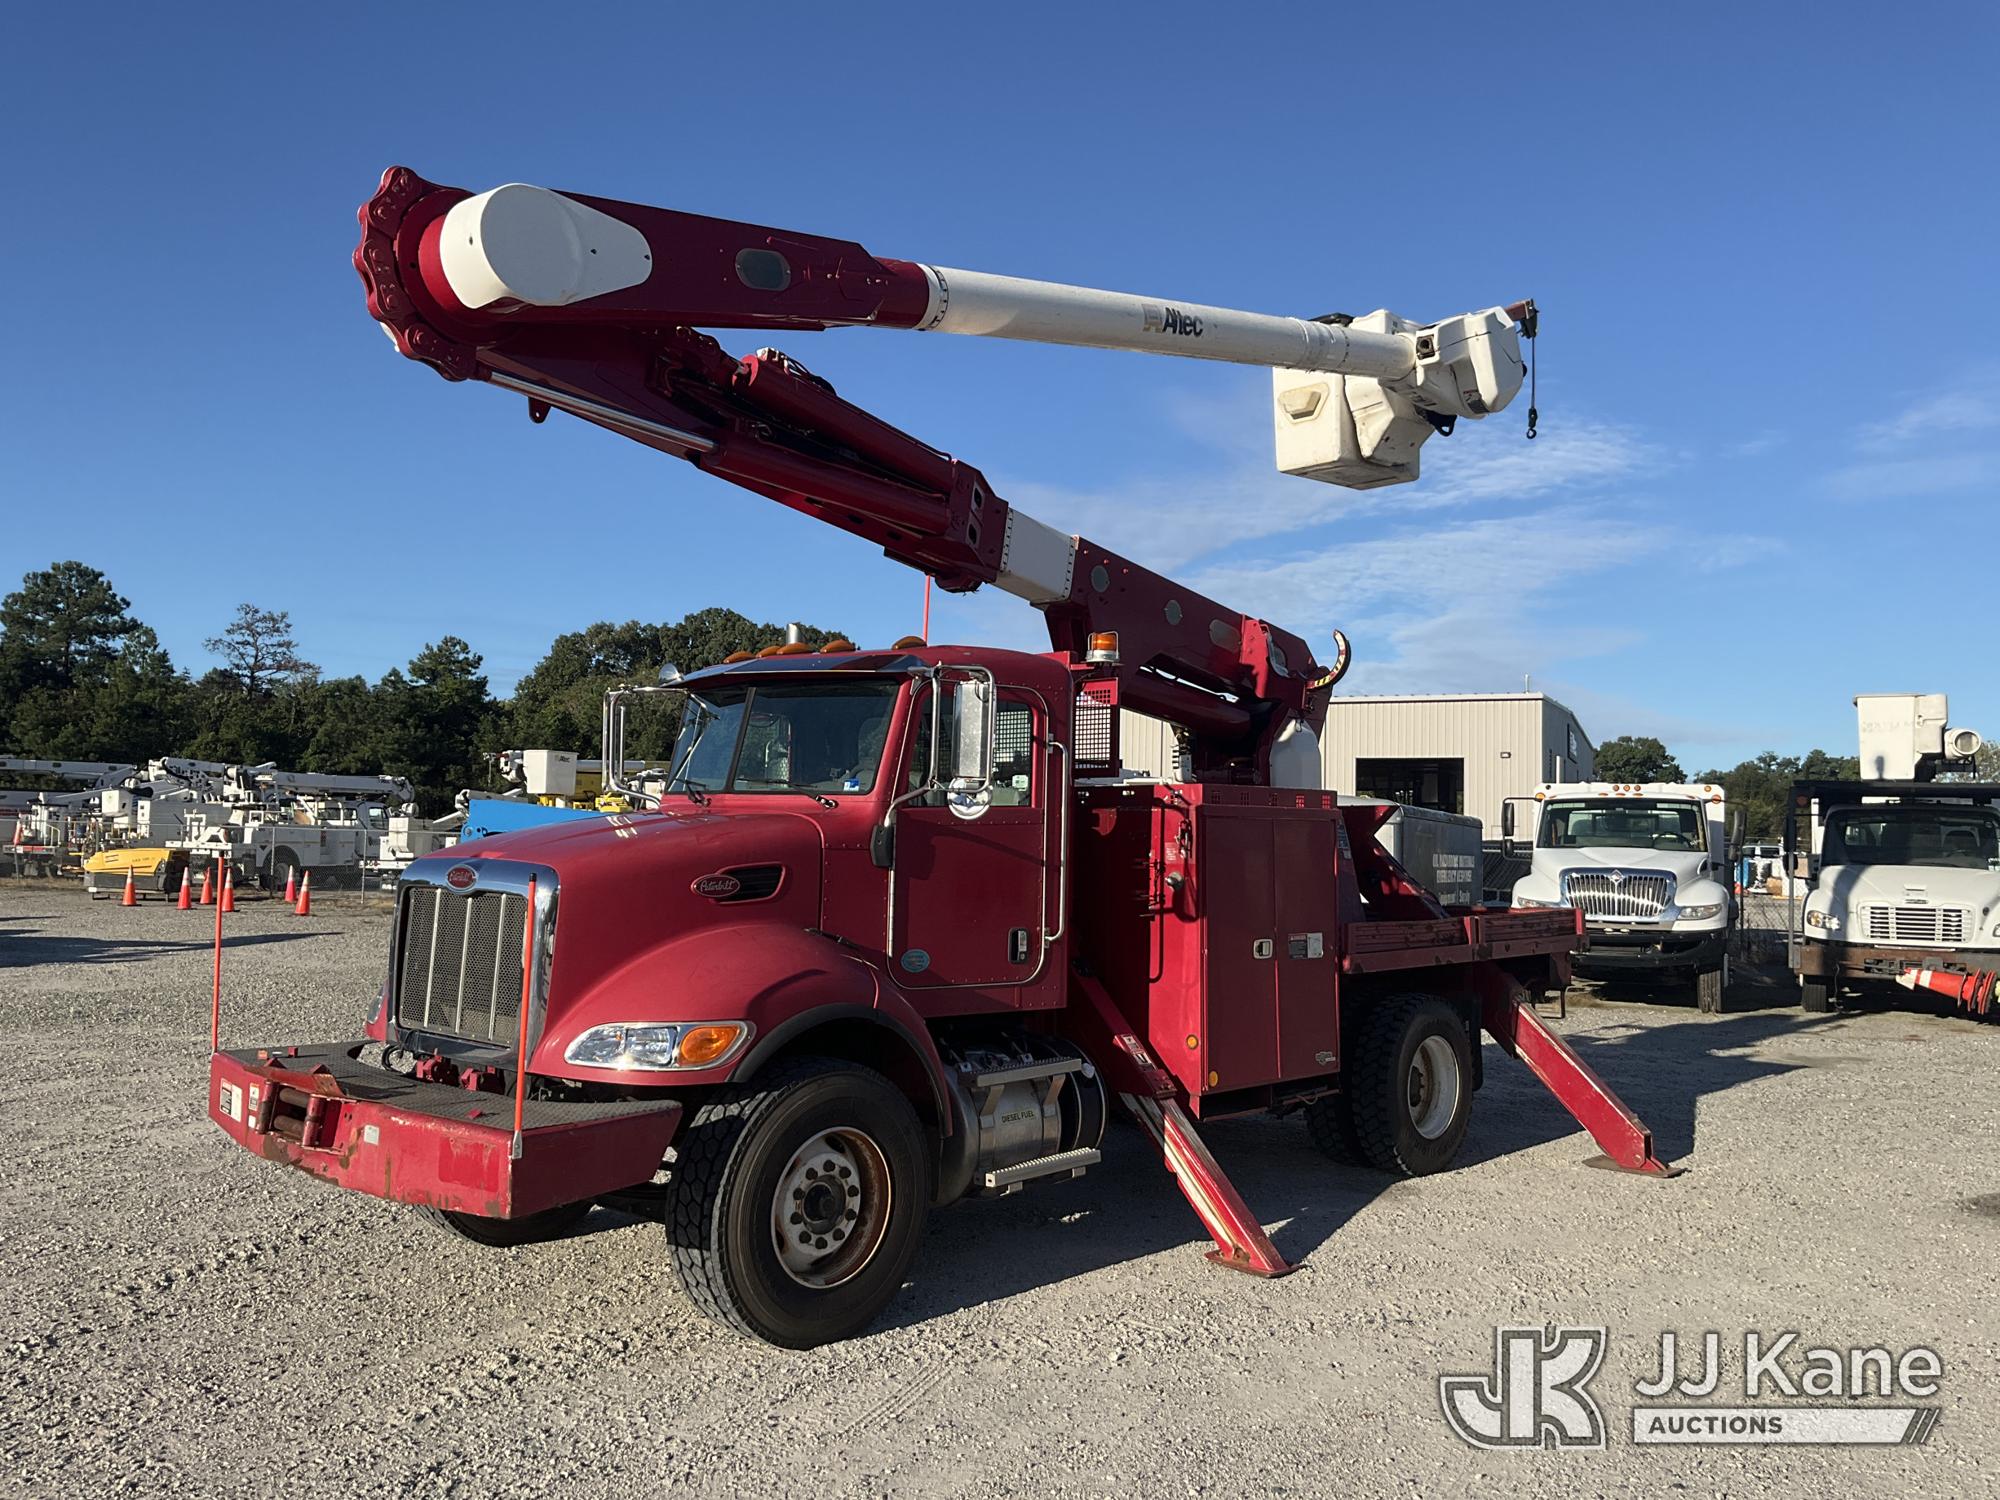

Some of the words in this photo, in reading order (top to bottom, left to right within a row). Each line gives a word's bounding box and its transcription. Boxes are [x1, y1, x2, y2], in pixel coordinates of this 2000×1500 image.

[1162, 306, 1204, 337] Altec
[1001, 1113, 1021, 1123] DIESEL
[1021, 1110, 1034, 1119] FUEL
